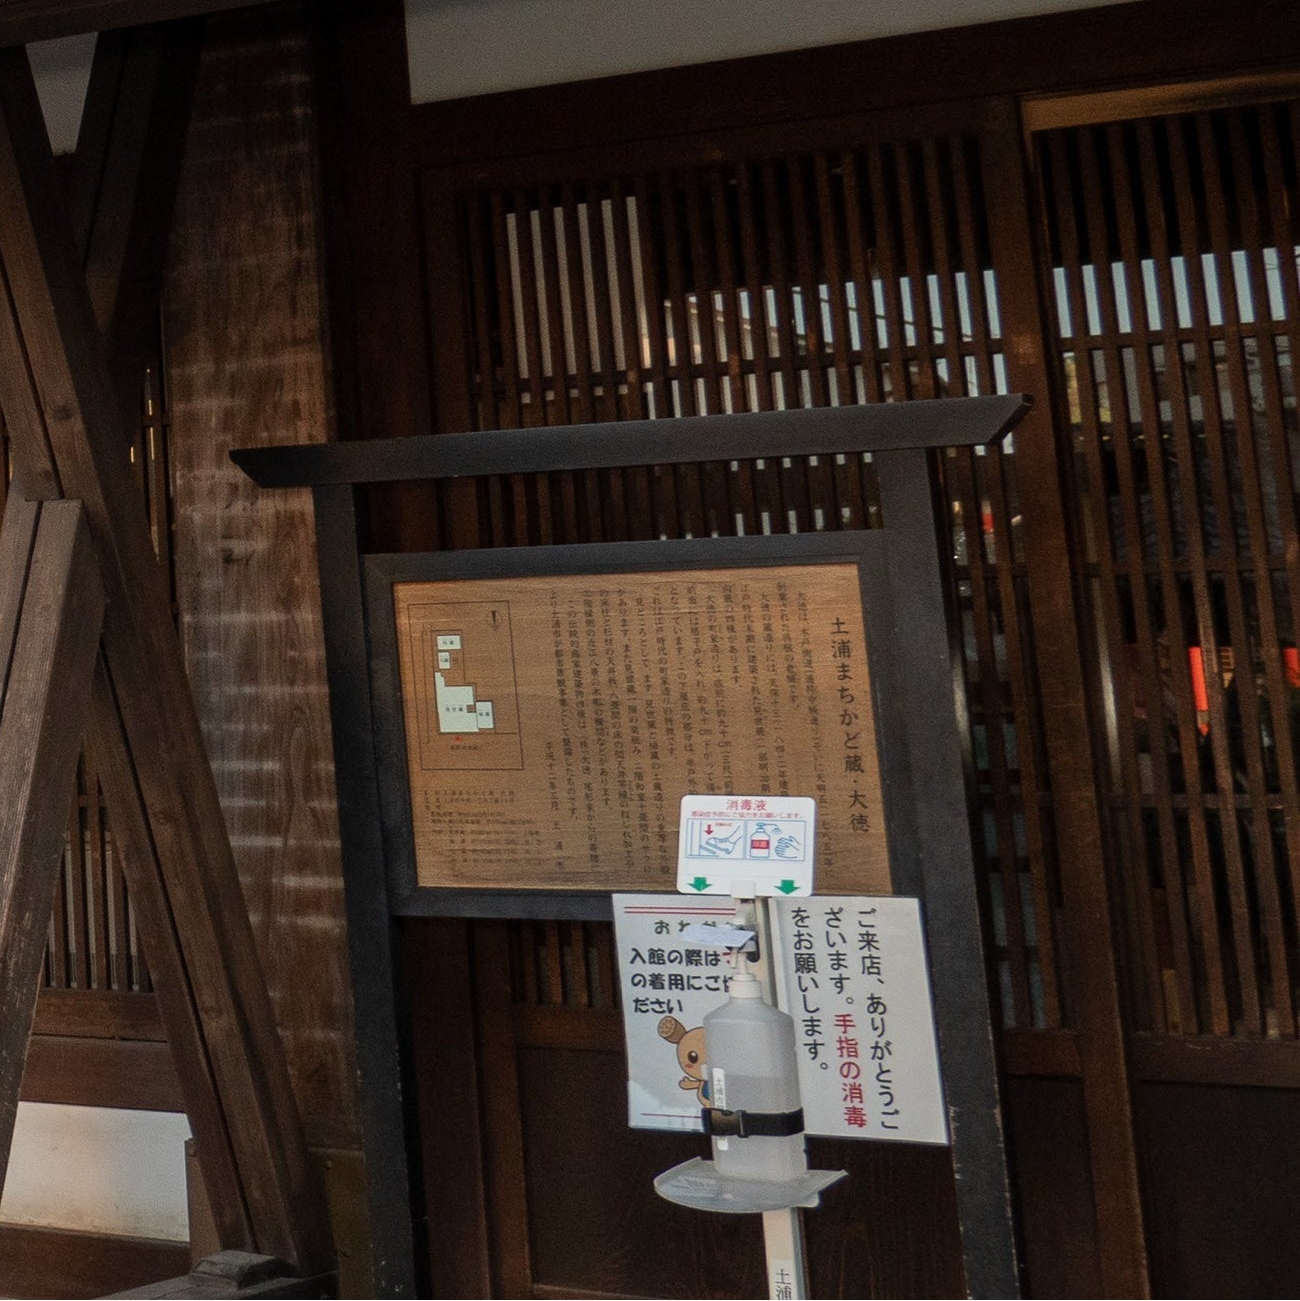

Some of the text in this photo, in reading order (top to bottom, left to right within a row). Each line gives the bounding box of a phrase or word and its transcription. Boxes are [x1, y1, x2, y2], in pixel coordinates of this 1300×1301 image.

[726, 799, 767, 811] 消毒液
[633, 997, 684, 1014] ださい
[792, 907, 828, 1070] をお願いします。
[824, 907, 866, 1128] ざいます。手指の消毒
[857, 908, 899, 1130] ご来店、ありがとうご
